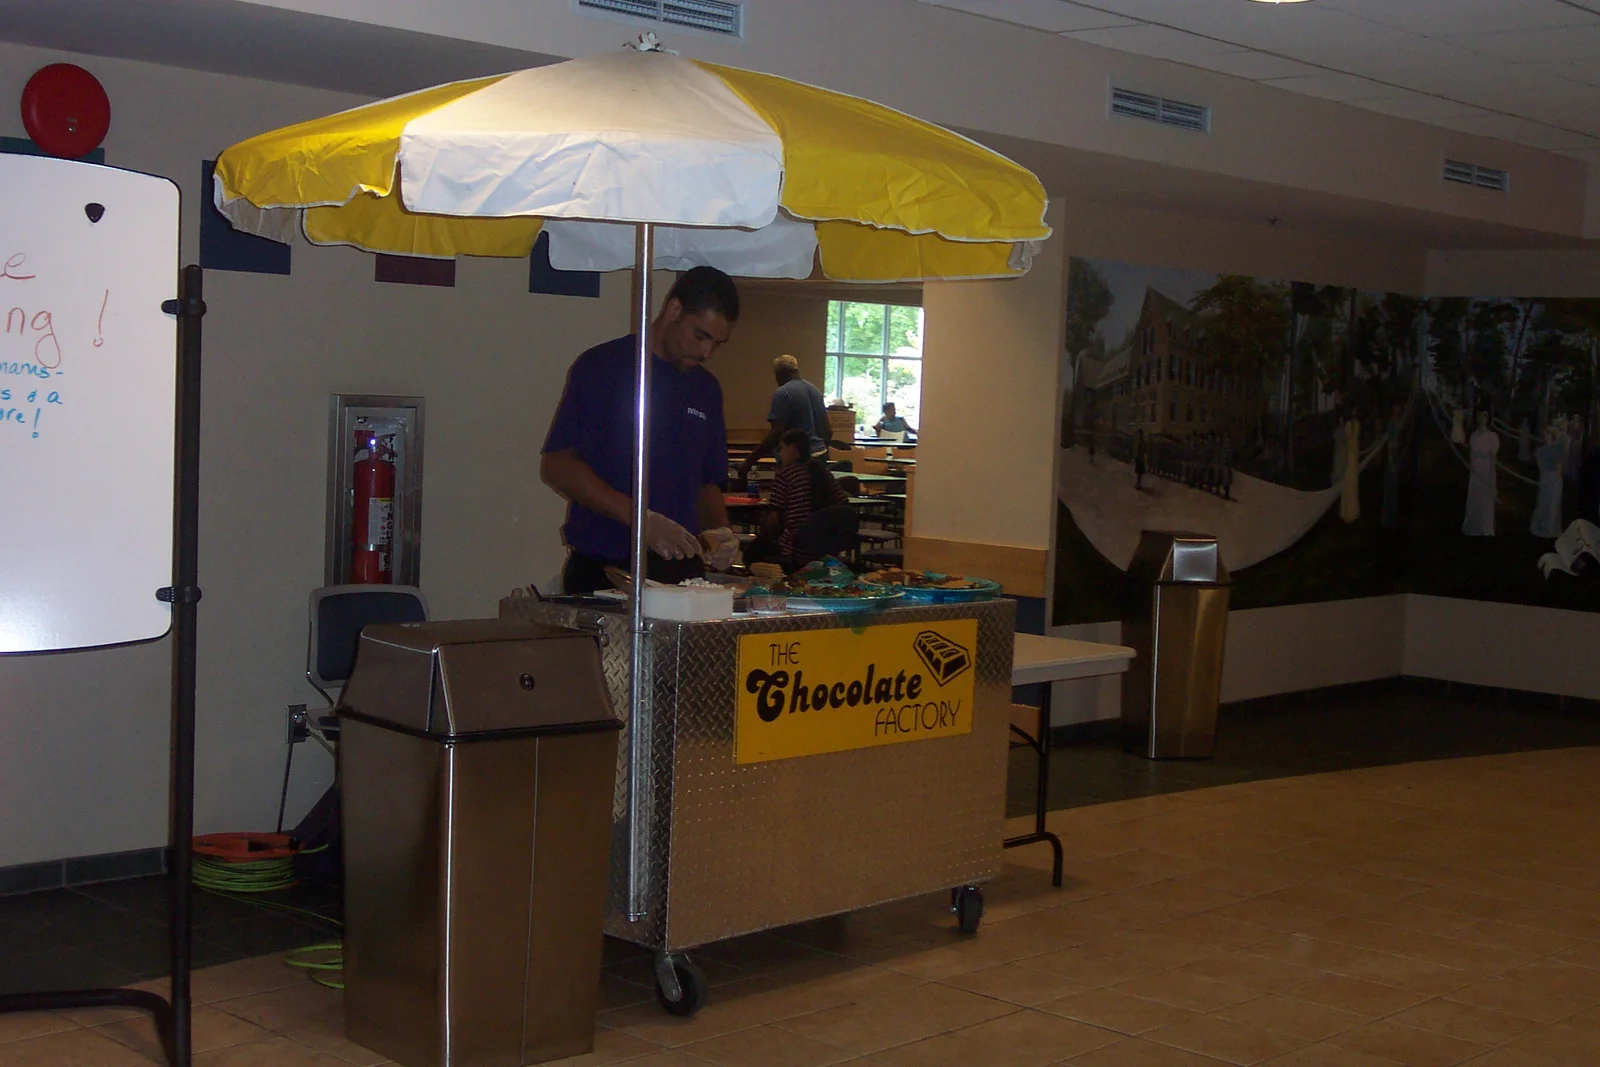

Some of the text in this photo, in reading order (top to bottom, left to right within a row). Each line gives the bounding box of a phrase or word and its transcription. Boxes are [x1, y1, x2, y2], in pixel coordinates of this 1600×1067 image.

[769, 641, 801, 666] THE
[745, 663, 922, 722] Chocolate
[874, 699, 961, 736] FACTORY
